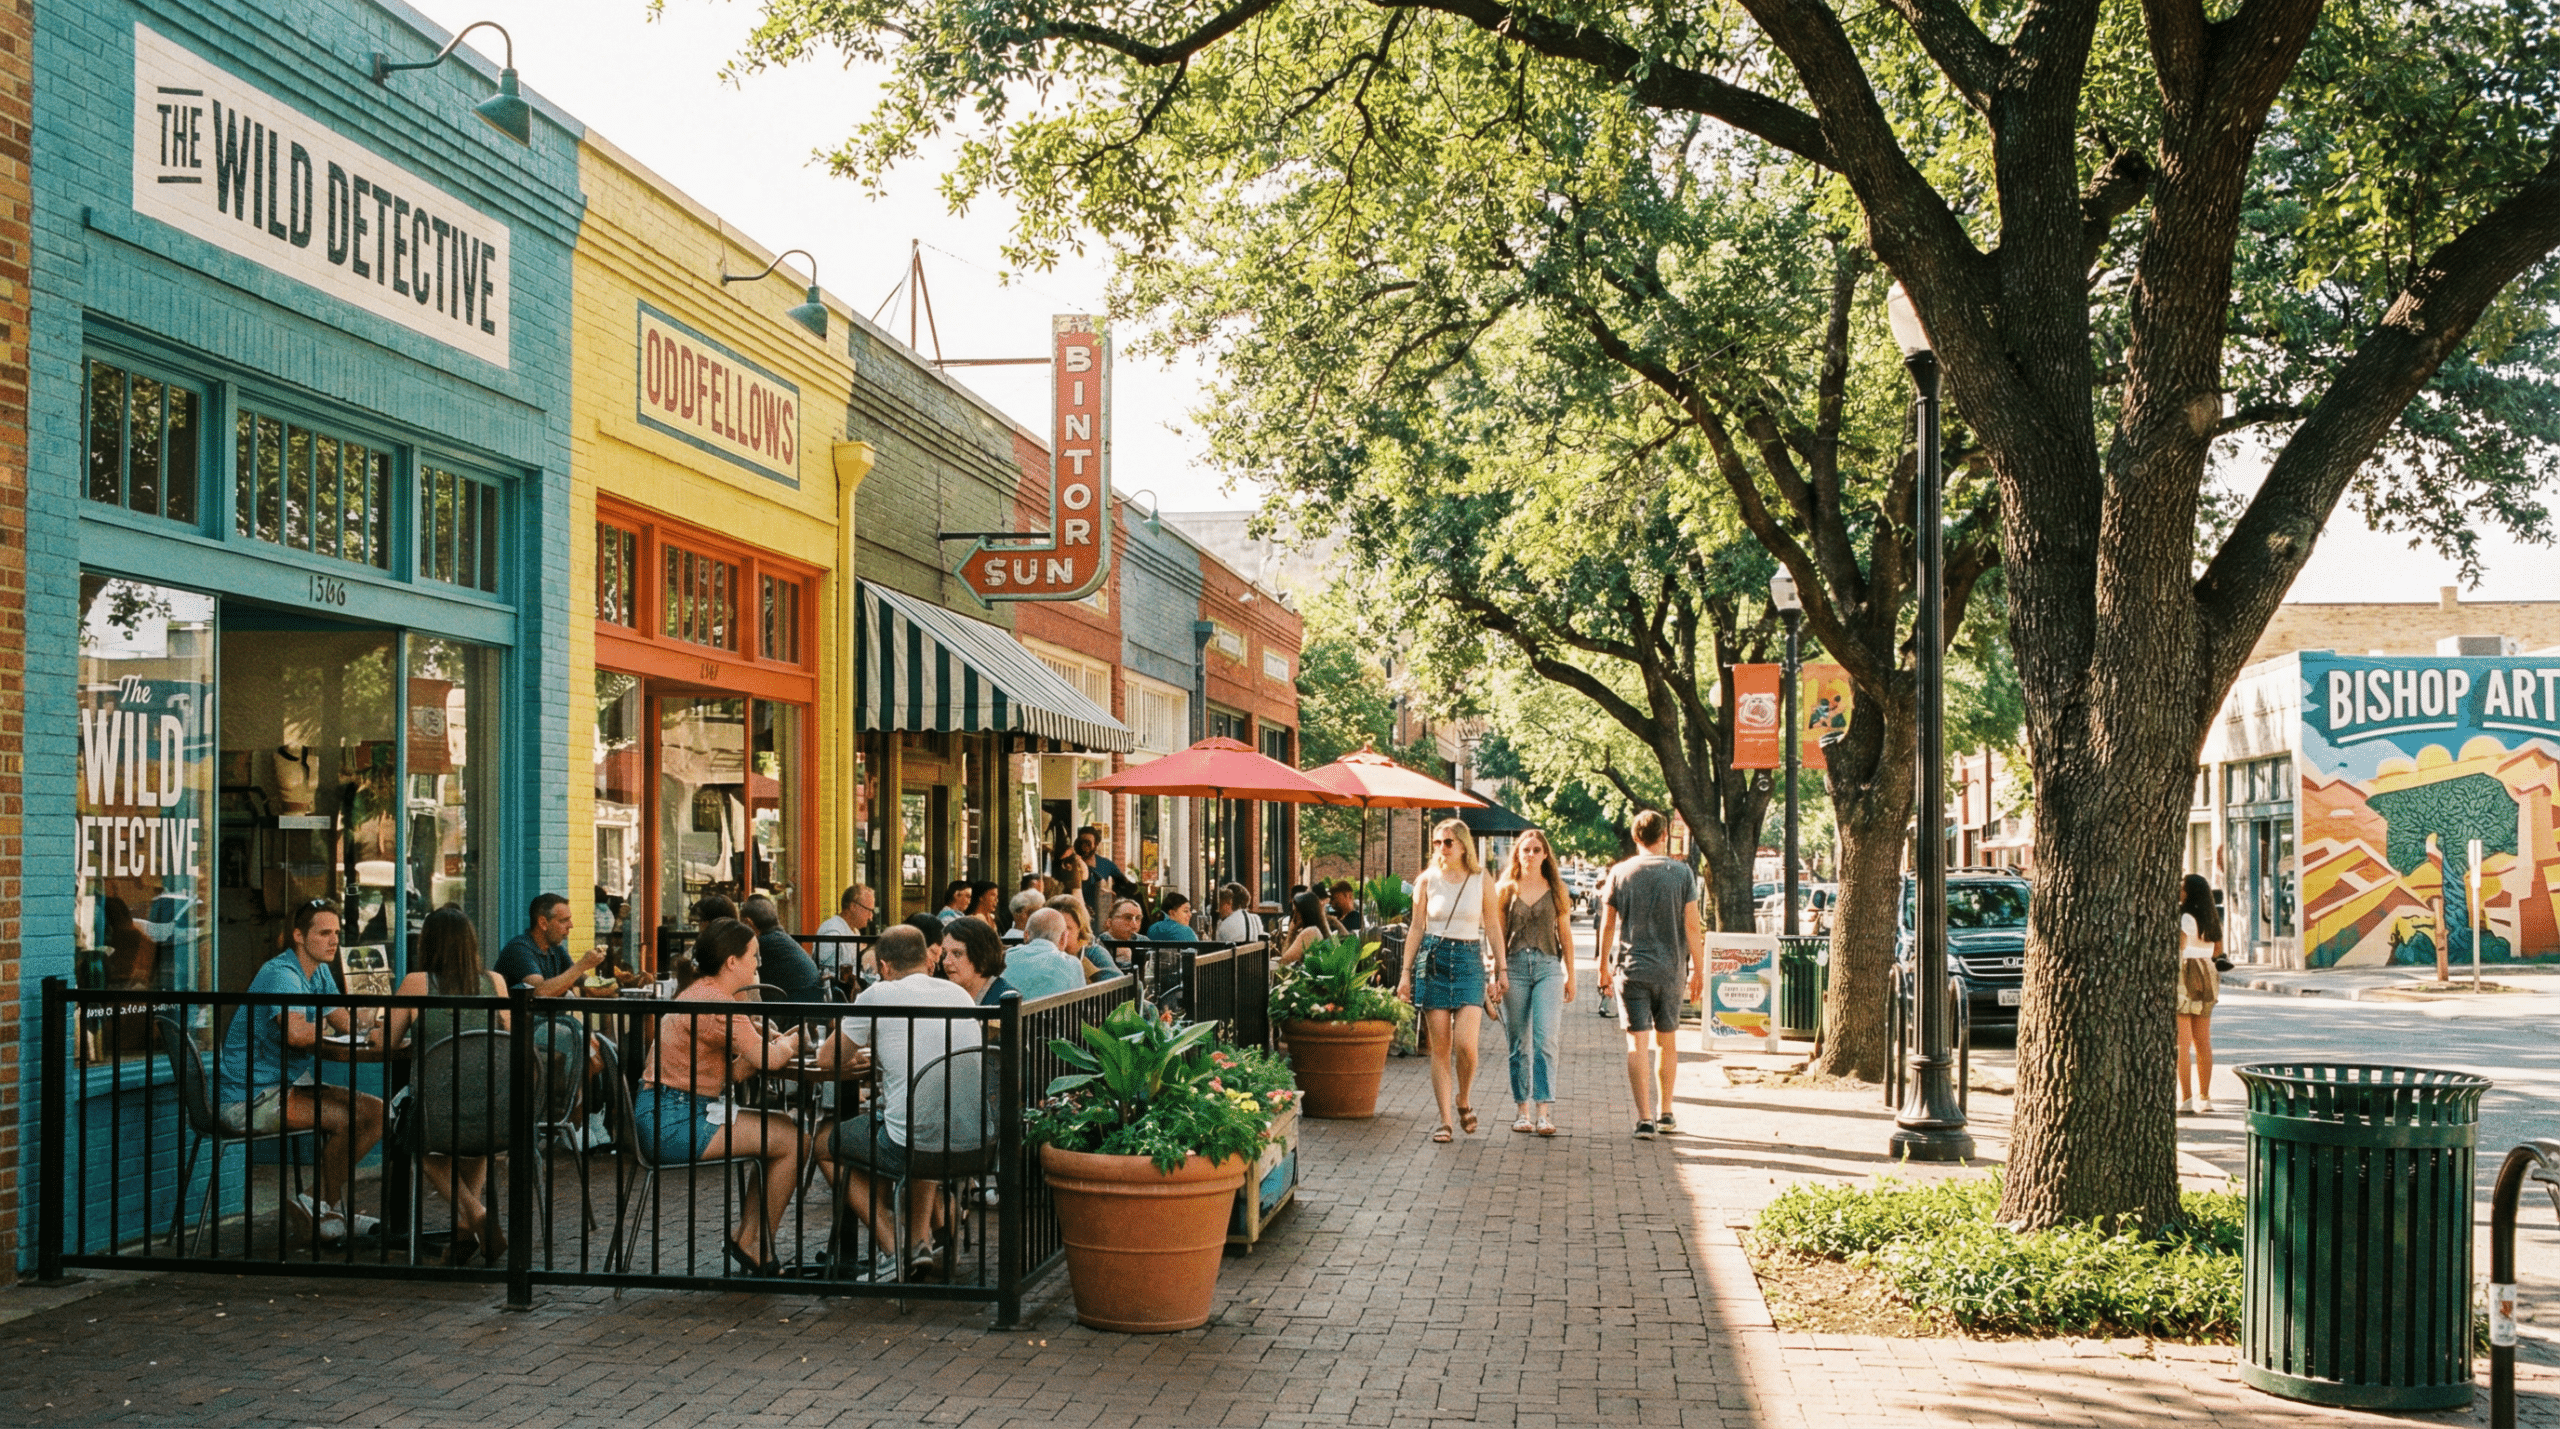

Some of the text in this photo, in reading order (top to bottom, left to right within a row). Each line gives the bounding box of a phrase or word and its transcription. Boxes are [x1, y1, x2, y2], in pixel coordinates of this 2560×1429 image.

[157, 99, 496, 337] THE WILD DETECTIVE
[646, 327, 796, 466] ODDFELLOWS
[1064, 345, 1093, 547] BINTOR
[984, 556, 1074, 586] SUN
[118, 674, 153, 704] The
[2329, 668, 2560, 731] BISHOP ART
[82, 708, 184, 808] WILD
